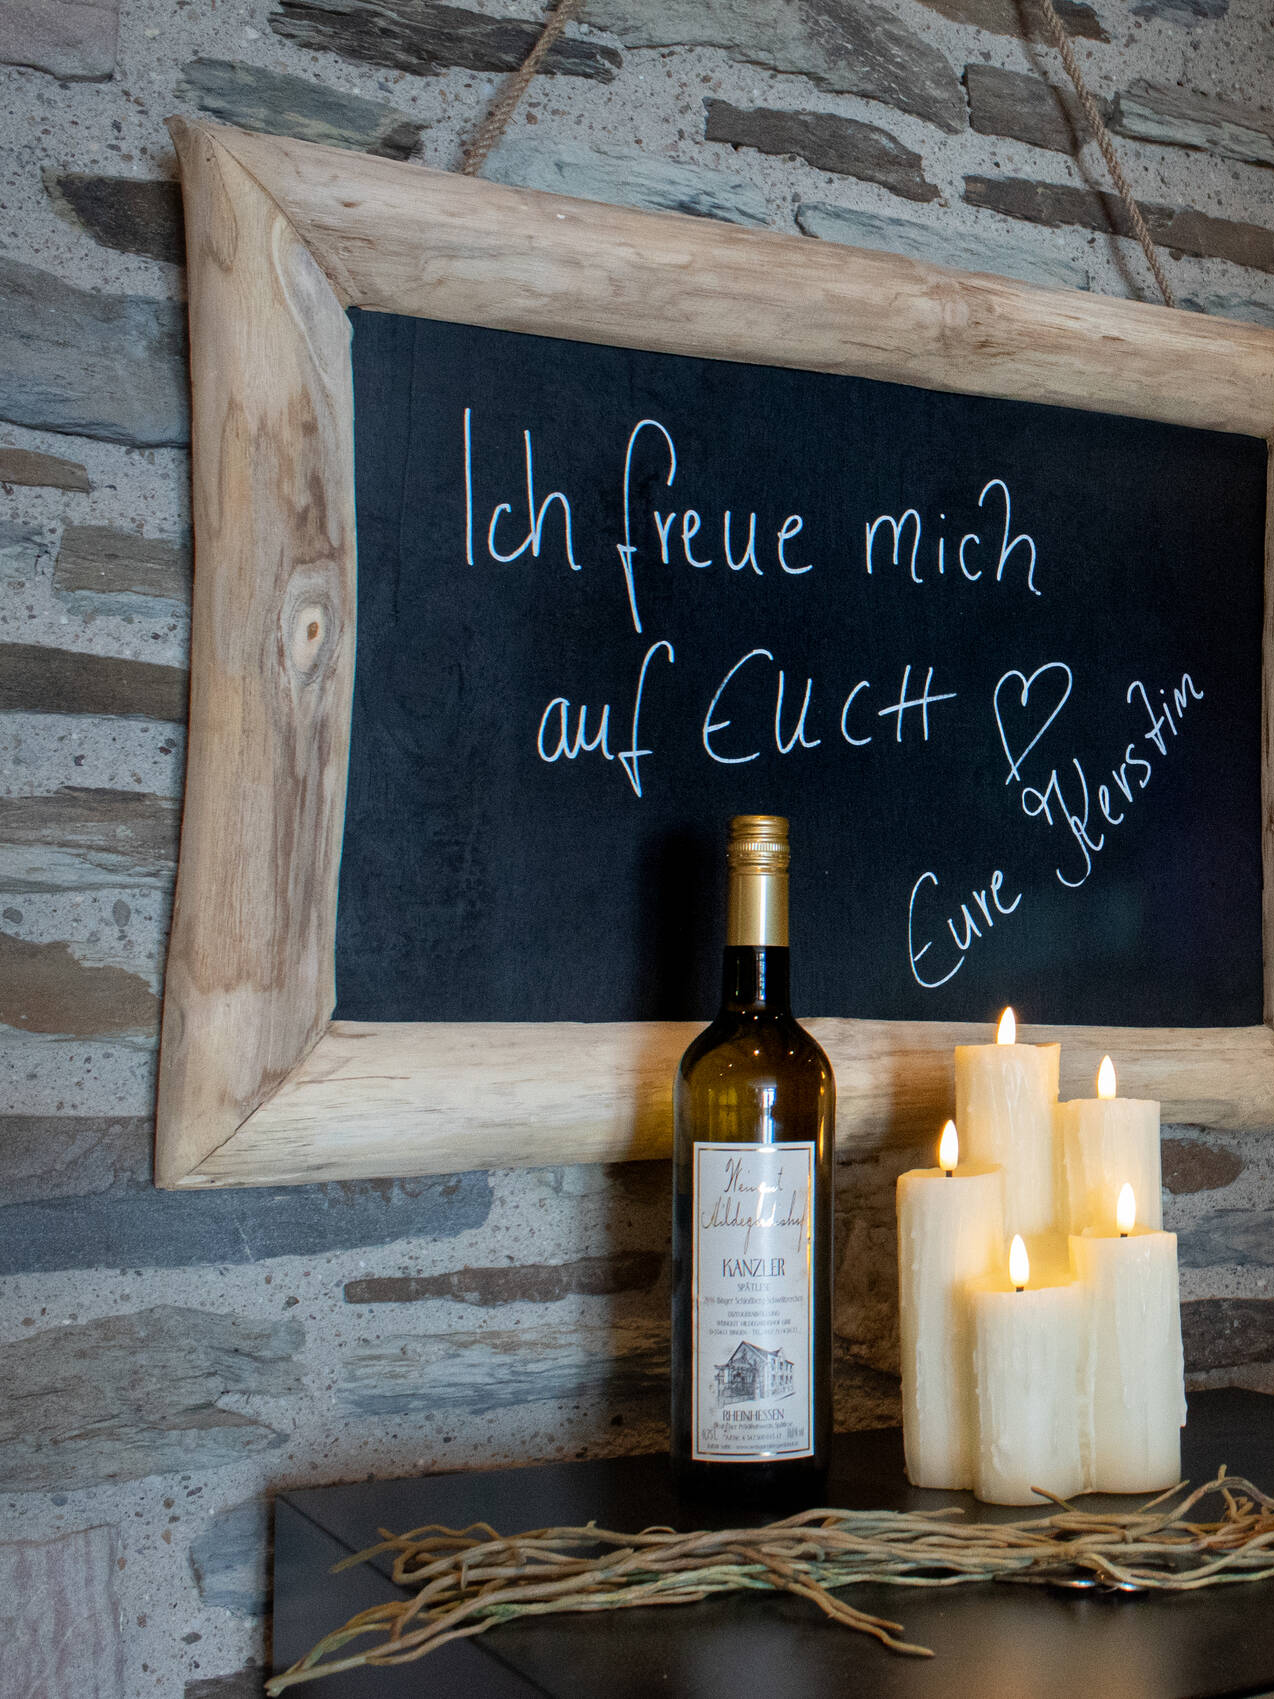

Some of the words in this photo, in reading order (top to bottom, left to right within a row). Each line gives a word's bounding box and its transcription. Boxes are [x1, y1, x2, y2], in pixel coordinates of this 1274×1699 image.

[463, 406, 582, 573] Ich
[616, 418, 813, 634] freue
[864, 478, 1042, 596] mich
[537, 640, 675, 799] auf
[908, 870, 1023, 989] Eure
[1021, 672, 1205, 889] Kerstin
[722, 1157, 784, 1203] Weint
[721, 1257, 786, 1278] KANZLER
[721, 1408, 786, 1423] RHEINHESSEN
